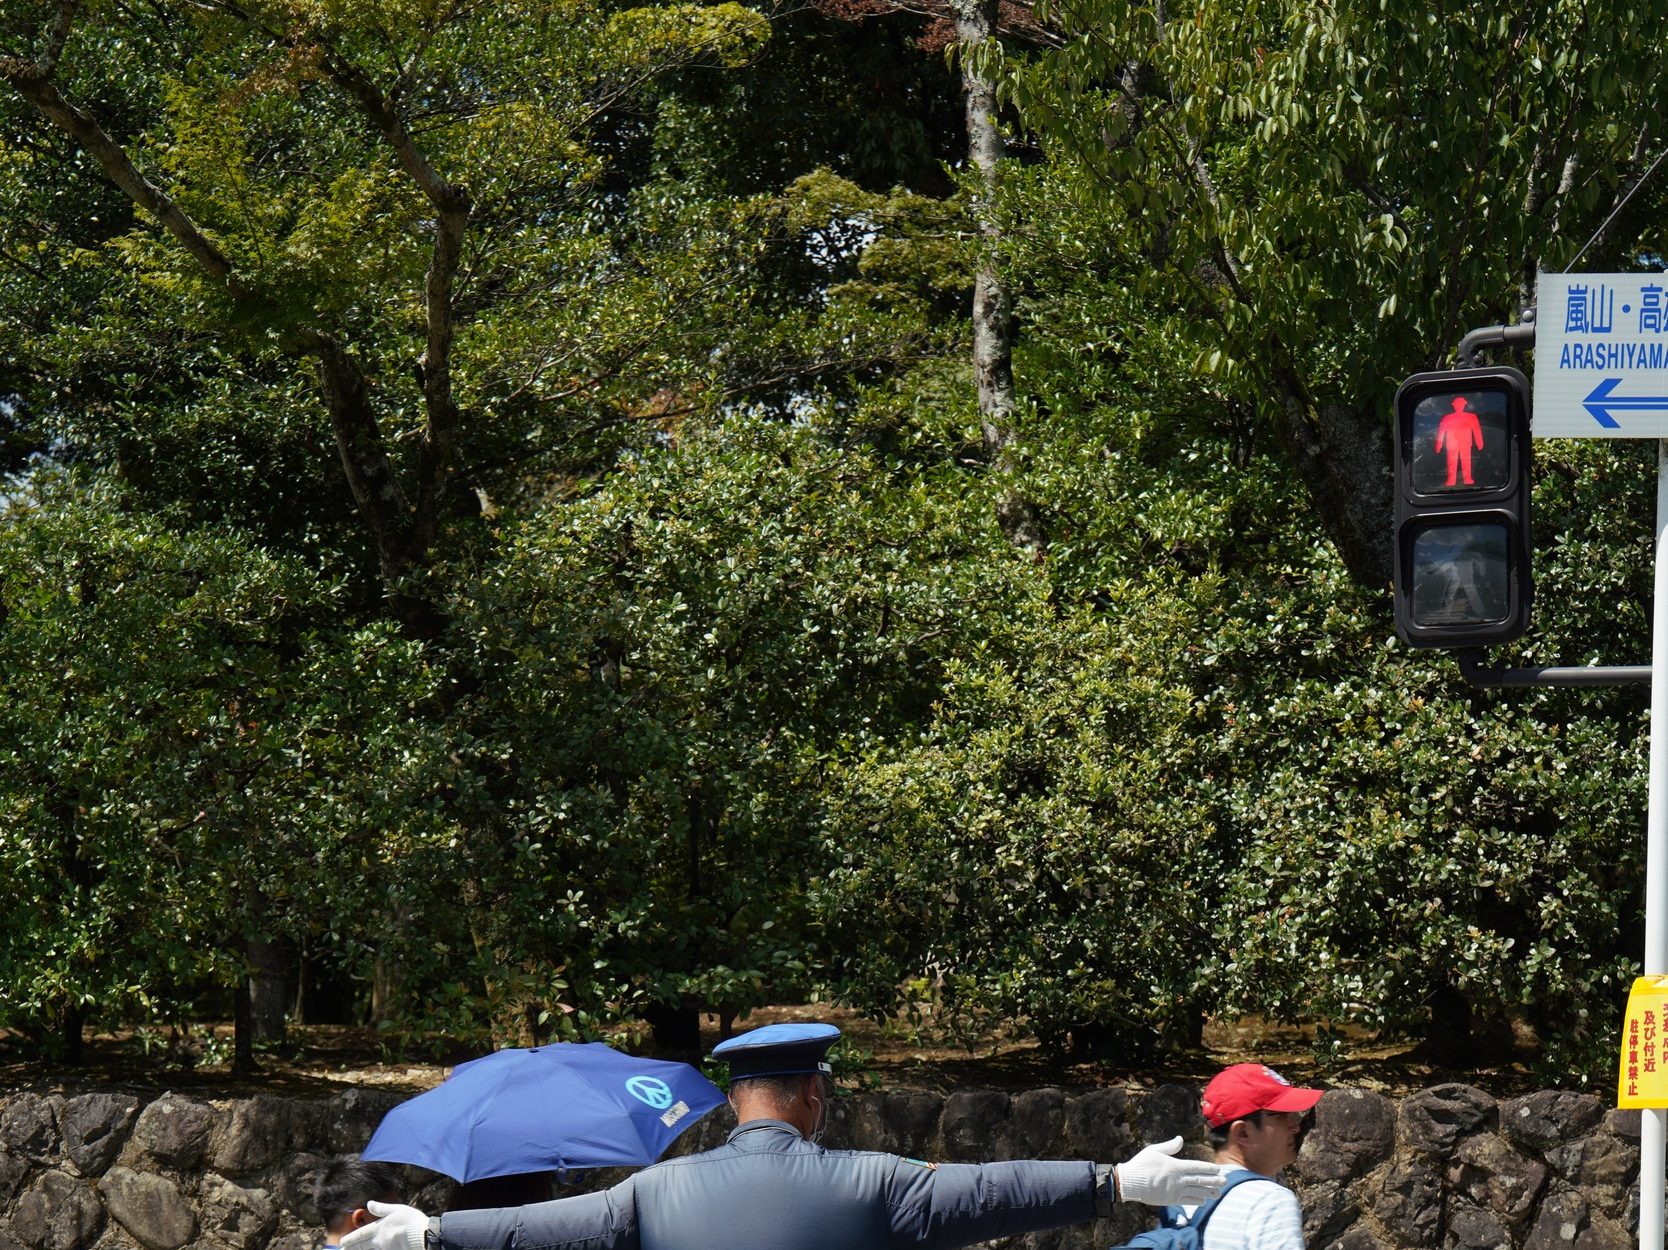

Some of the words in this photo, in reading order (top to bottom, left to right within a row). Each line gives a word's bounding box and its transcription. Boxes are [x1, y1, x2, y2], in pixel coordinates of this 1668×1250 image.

[1565, 283, 1668, 334] 嵐山・高
[1627, 1019, 1639, 1096] 駐停車禁止
[1643, 1010, 1656, 1073] 及び付近
